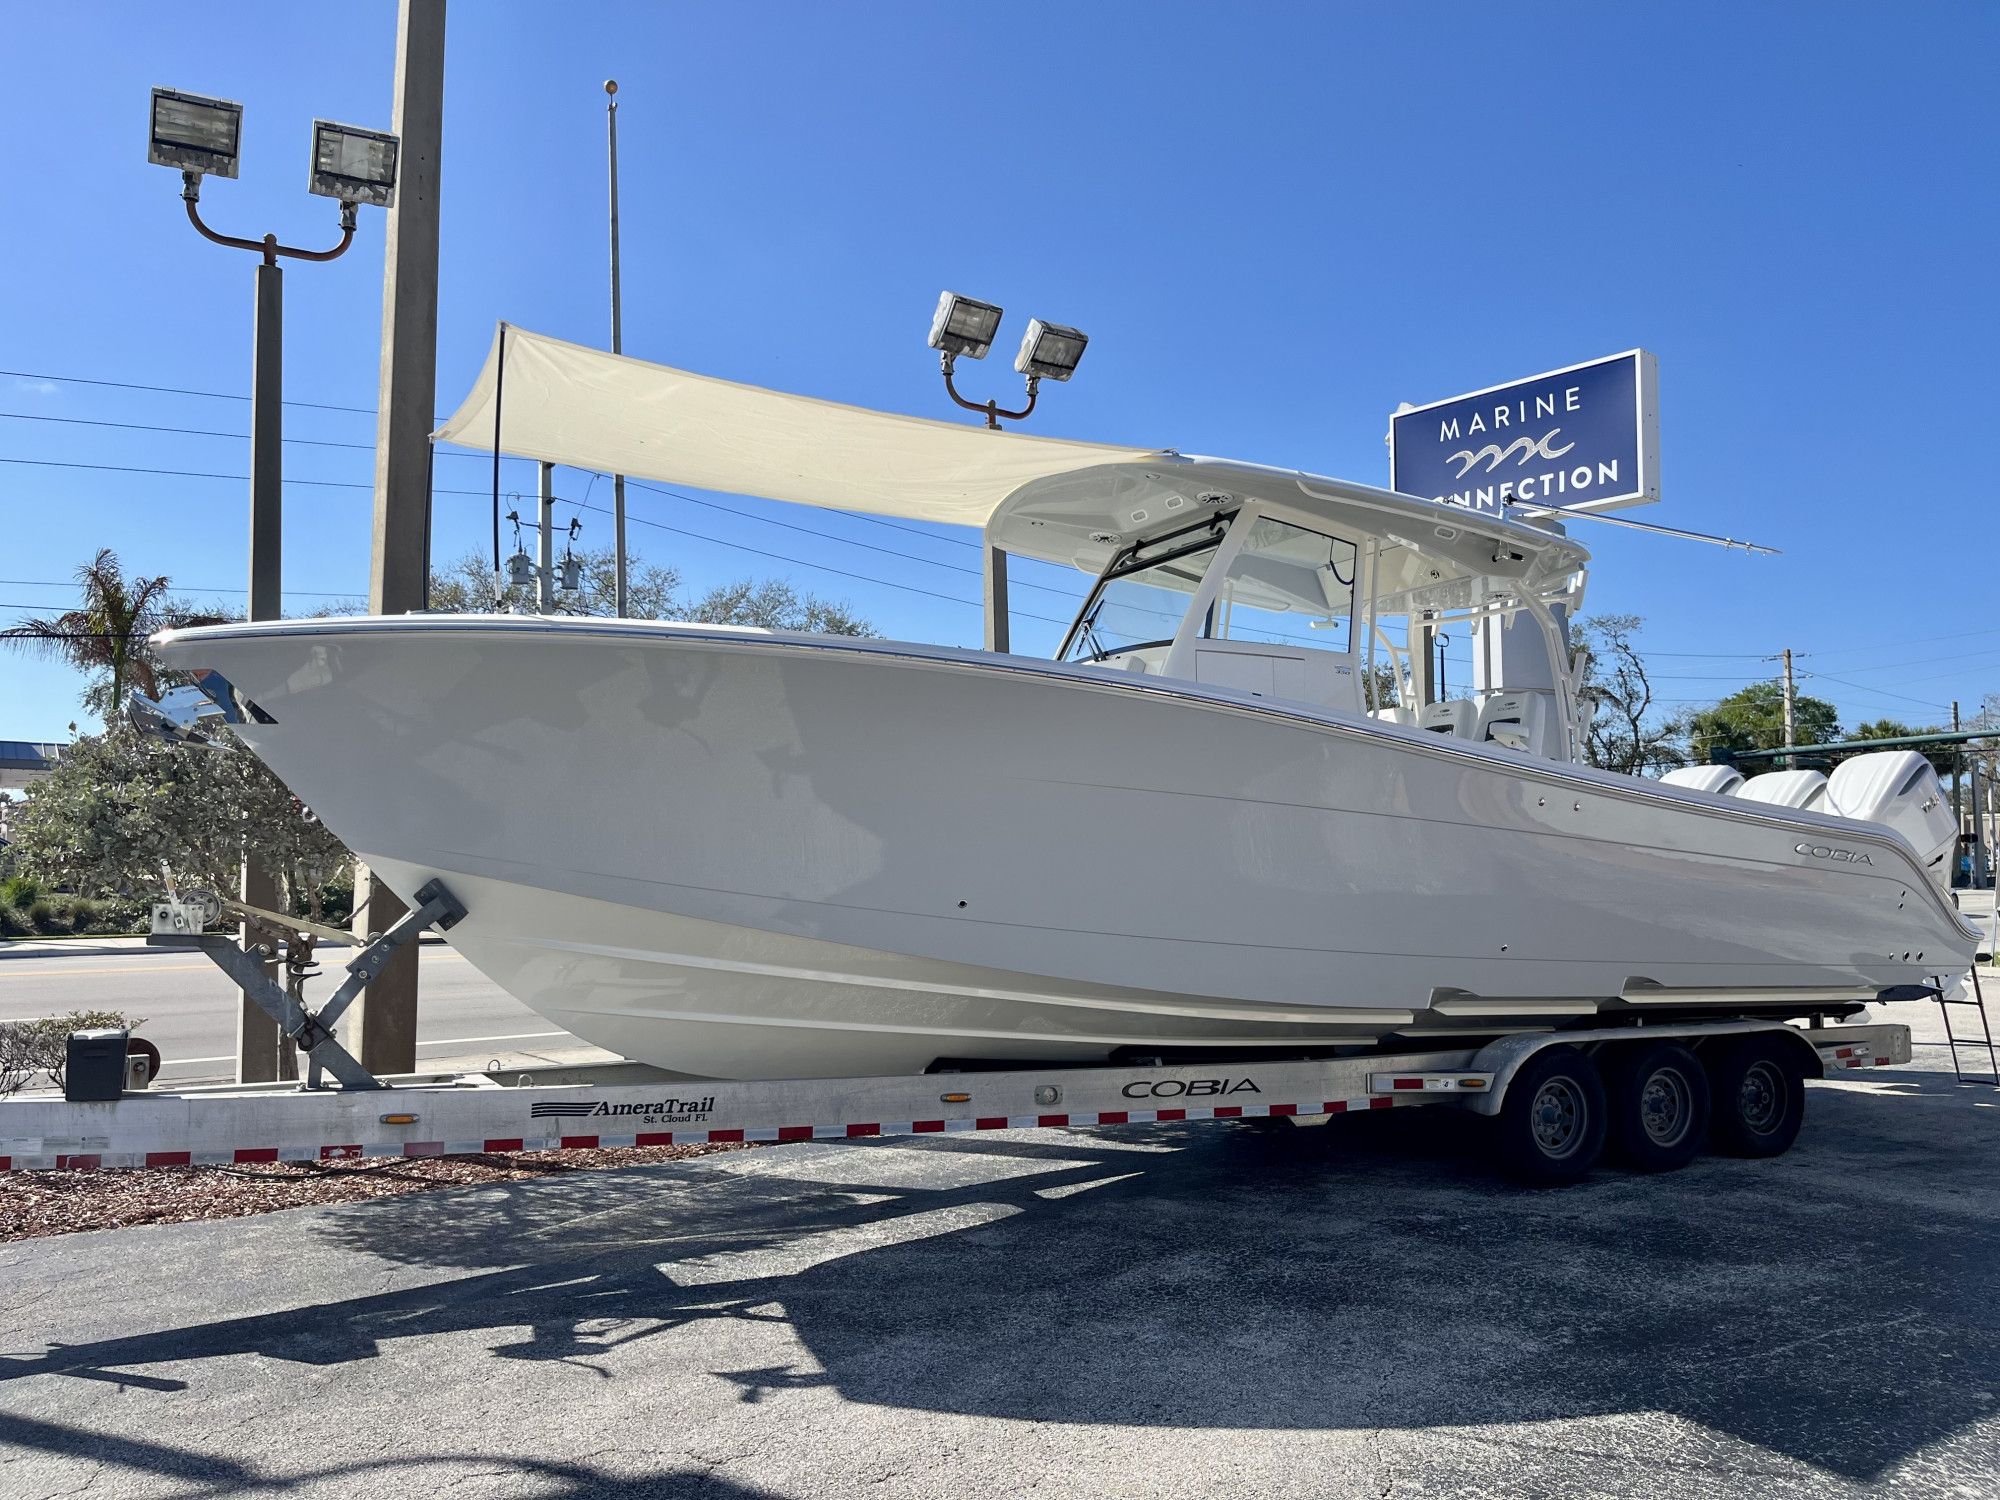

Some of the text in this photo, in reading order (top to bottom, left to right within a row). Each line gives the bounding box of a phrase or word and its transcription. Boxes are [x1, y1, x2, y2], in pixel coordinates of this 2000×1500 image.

[1440, 387, 1580, 442] MARINE
[1433, 459, 1618, 509] NNECTION
[1795, 843, 1875, 866] COBIA
[1121, 1078, 1261, 1098] COBIA
[593, 1097, 715, 1116] AmeraTrail
[643, 1113, 708, 1124] St. Cloud FL
